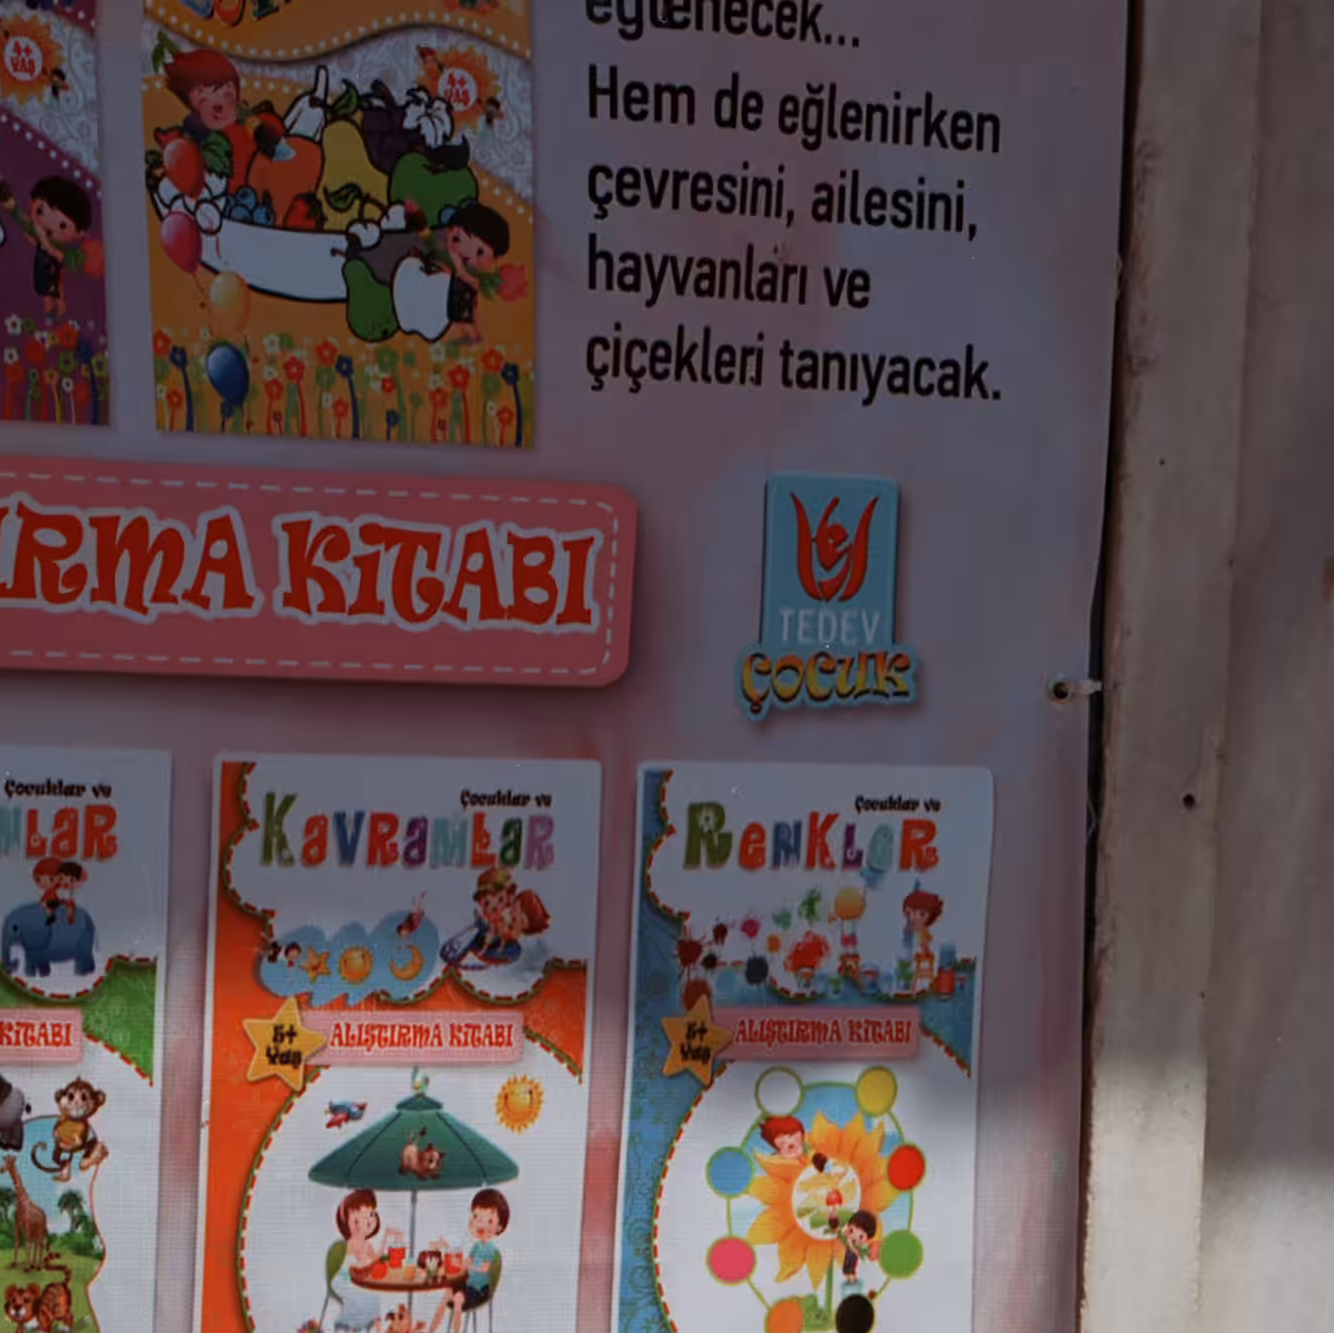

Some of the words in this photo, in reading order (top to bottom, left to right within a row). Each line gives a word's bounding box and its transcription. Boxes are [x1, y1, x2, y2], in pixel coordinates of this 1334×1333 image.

[13, 40, 35, 56] 4+
[447, 72, 470, 88] 4+
[588, 64, 695, 127] Hem
[714, 72, 764, 132] de
[777, 82, 1001, 154] eğlenirken
[587, 159, 795, 229] çevresini,
[810, 166, 977, 242] ailesini,
[587, 232, 807, 309] hayvanları
[822, 263, 871, 309] ve
[585, 321, 764, 394] çiçekleri
[779, 339, 1002, 408] tanıyacak.
[779, 608, 880, 646] TEDEV
[272, 1025, 298, 1044] 5+
[686, 1021, 708, 1039] 5+
